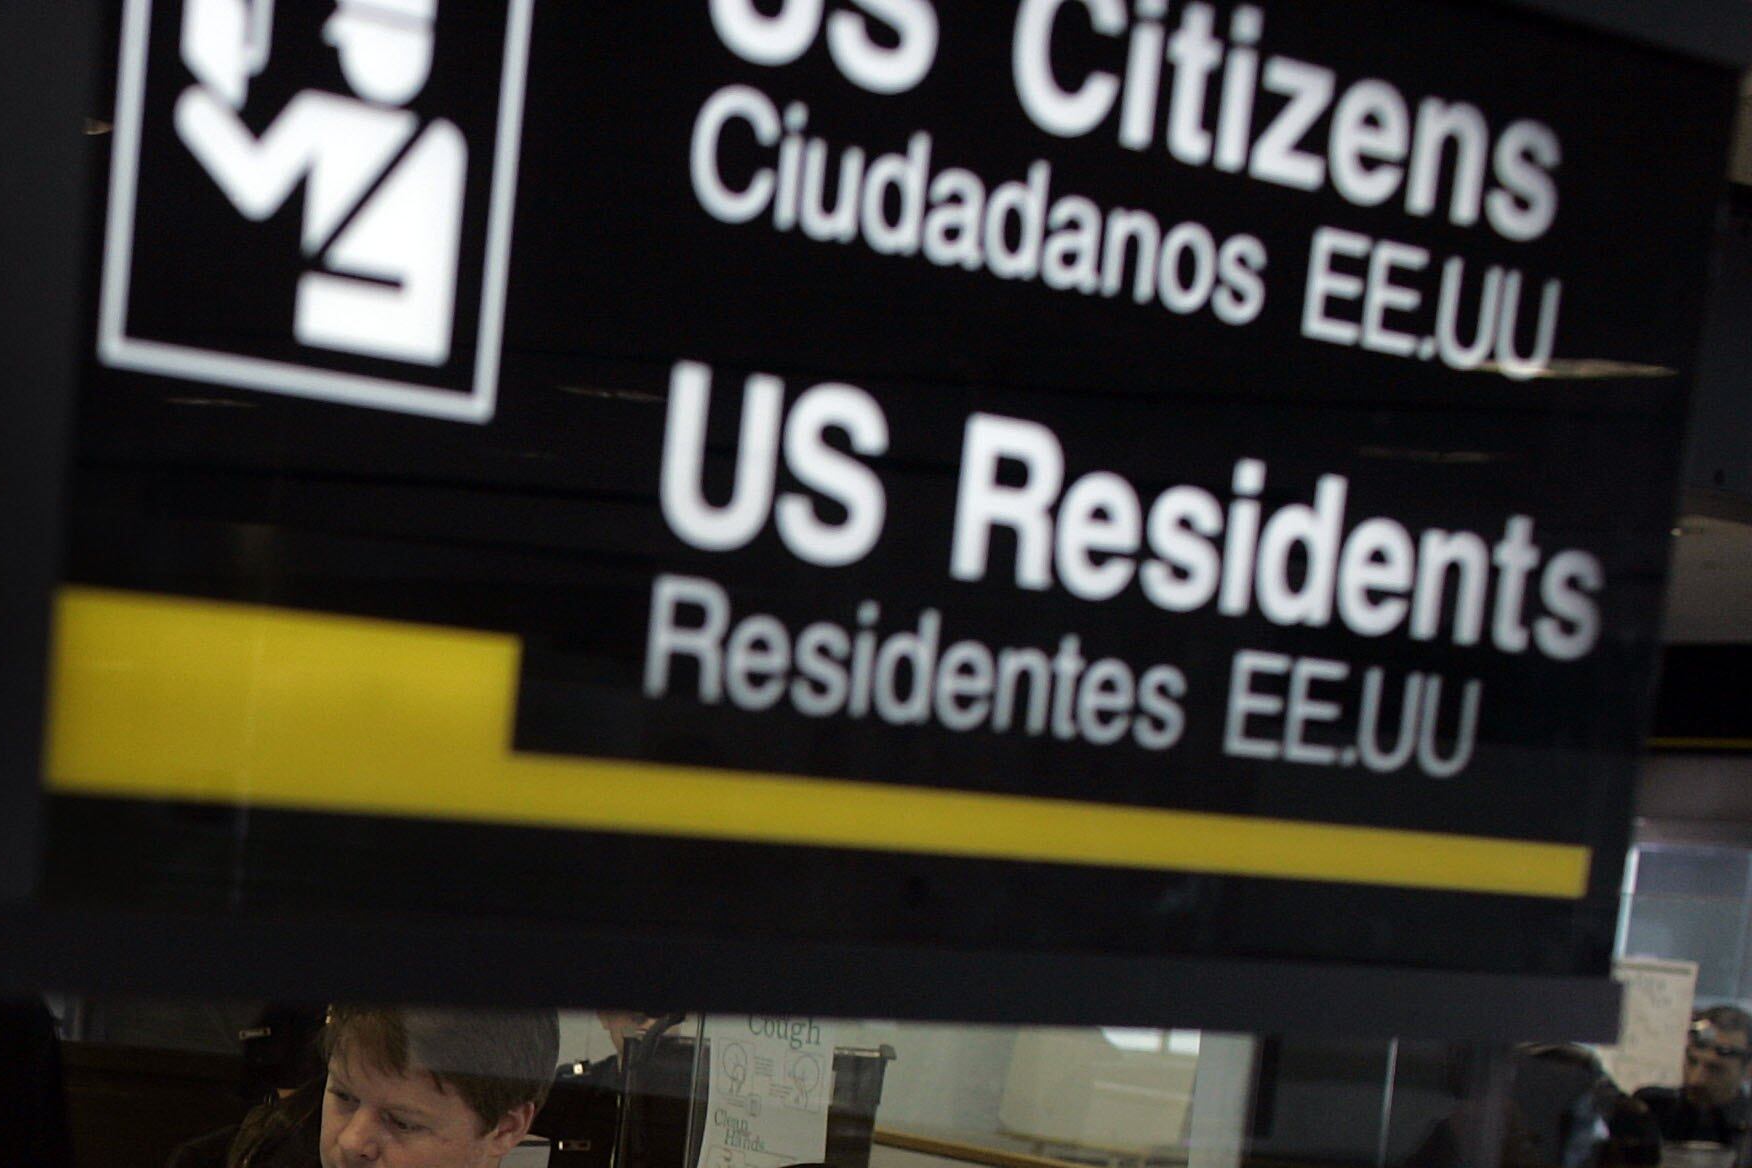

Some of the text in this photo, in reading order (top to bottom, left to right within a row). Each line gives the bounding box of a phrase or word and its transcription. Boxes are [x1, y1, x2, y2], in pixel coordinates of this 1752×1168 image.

[690, 85, 1562, 380] Ciudadanos EE.UU
[1013, 0, 1564, 243] Citizens
[660, 360, 1604, 660] US Residents
[644, 576, 1482, 778] Residentes EE.UU
[749, 1013, 821, 1049] Cough
